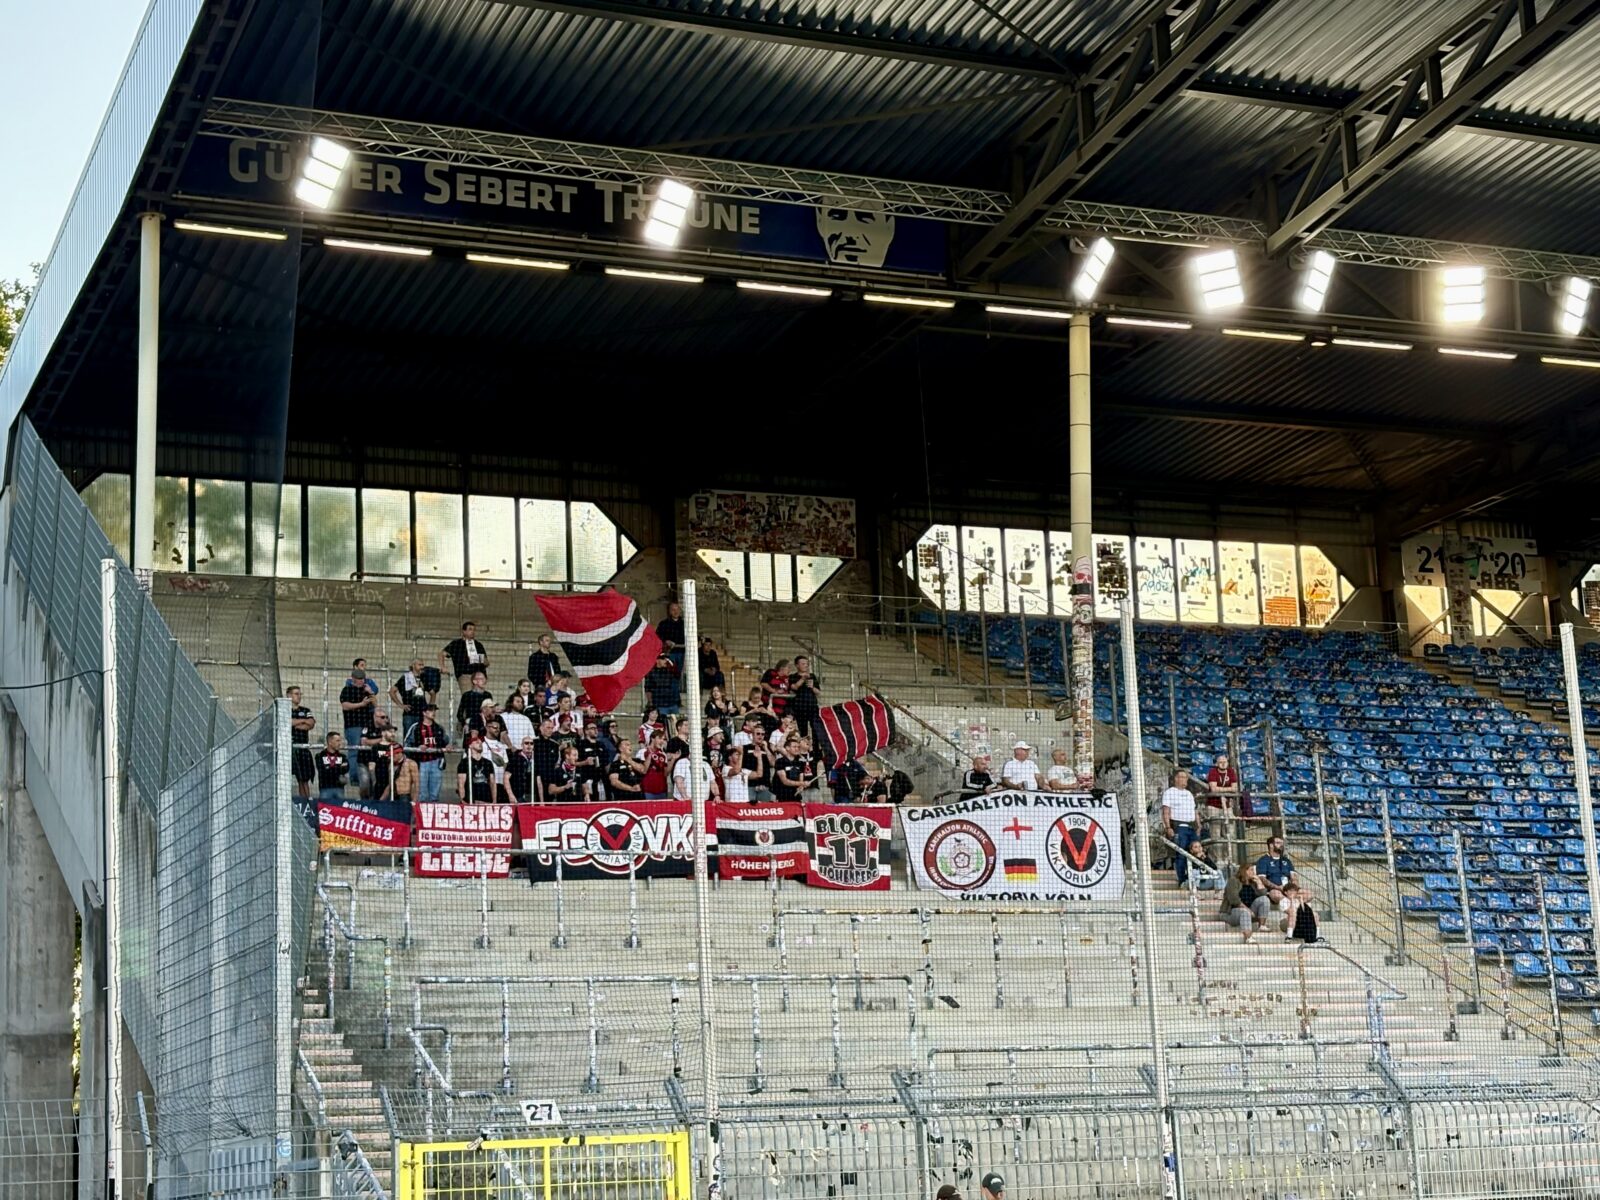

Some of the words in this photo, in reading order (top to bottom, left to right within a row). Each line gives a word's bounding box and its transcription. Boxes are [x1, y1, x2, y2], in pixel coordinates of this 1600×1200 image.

[228, 137, 402, 194] GÜER
[423, 161, 578, 214] SEBERT
[595, 181, 761, 235] TRÜNE
[420, 803, 513, 831] VEREINS
[606, 815, 623, 824] FC
[738, 807, 785, 817] JUNIORS
[907, 794, 1028, 821] CARSHALTON
[1034, 795, 1113, 808] ATHLETIC
[815, 815, 879, 838] BLOCK
[1068, 817, 1087, 827] 1904
[827, 837, 870, 866] 11
[1050, 843, 1092, 884] VIKTORIA
[1094, 844, 1108, 876] KÖLN
[526, 1104, 553, 1121] 27
